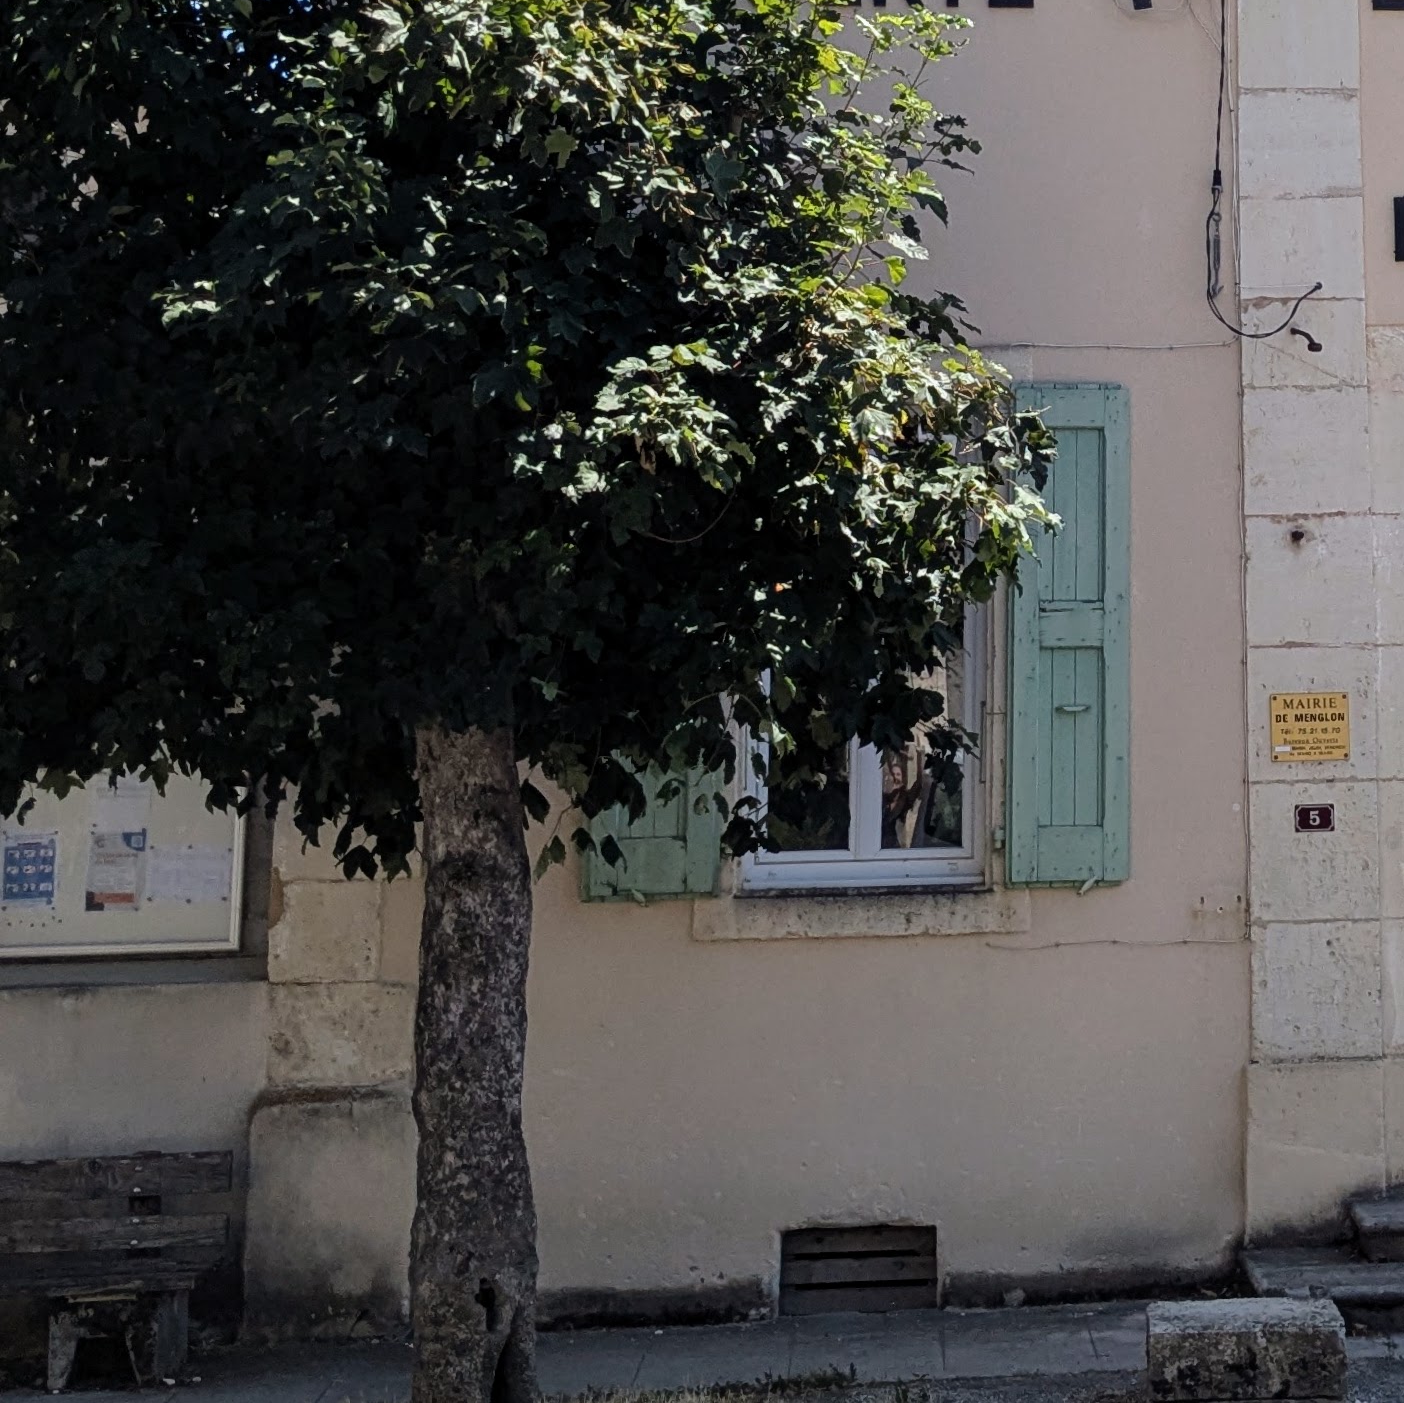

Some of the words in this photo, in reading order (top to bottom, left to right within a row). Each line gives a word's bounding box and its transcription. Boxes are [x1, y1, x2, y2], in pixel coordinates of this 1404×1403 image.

[1282, 697, 1337, 710] MAIRIE
[1275, 713, 1289, 723] DE
[1294, 712, 1345, 723] MENGLON
[1309, 810, 1320, 826] 5
